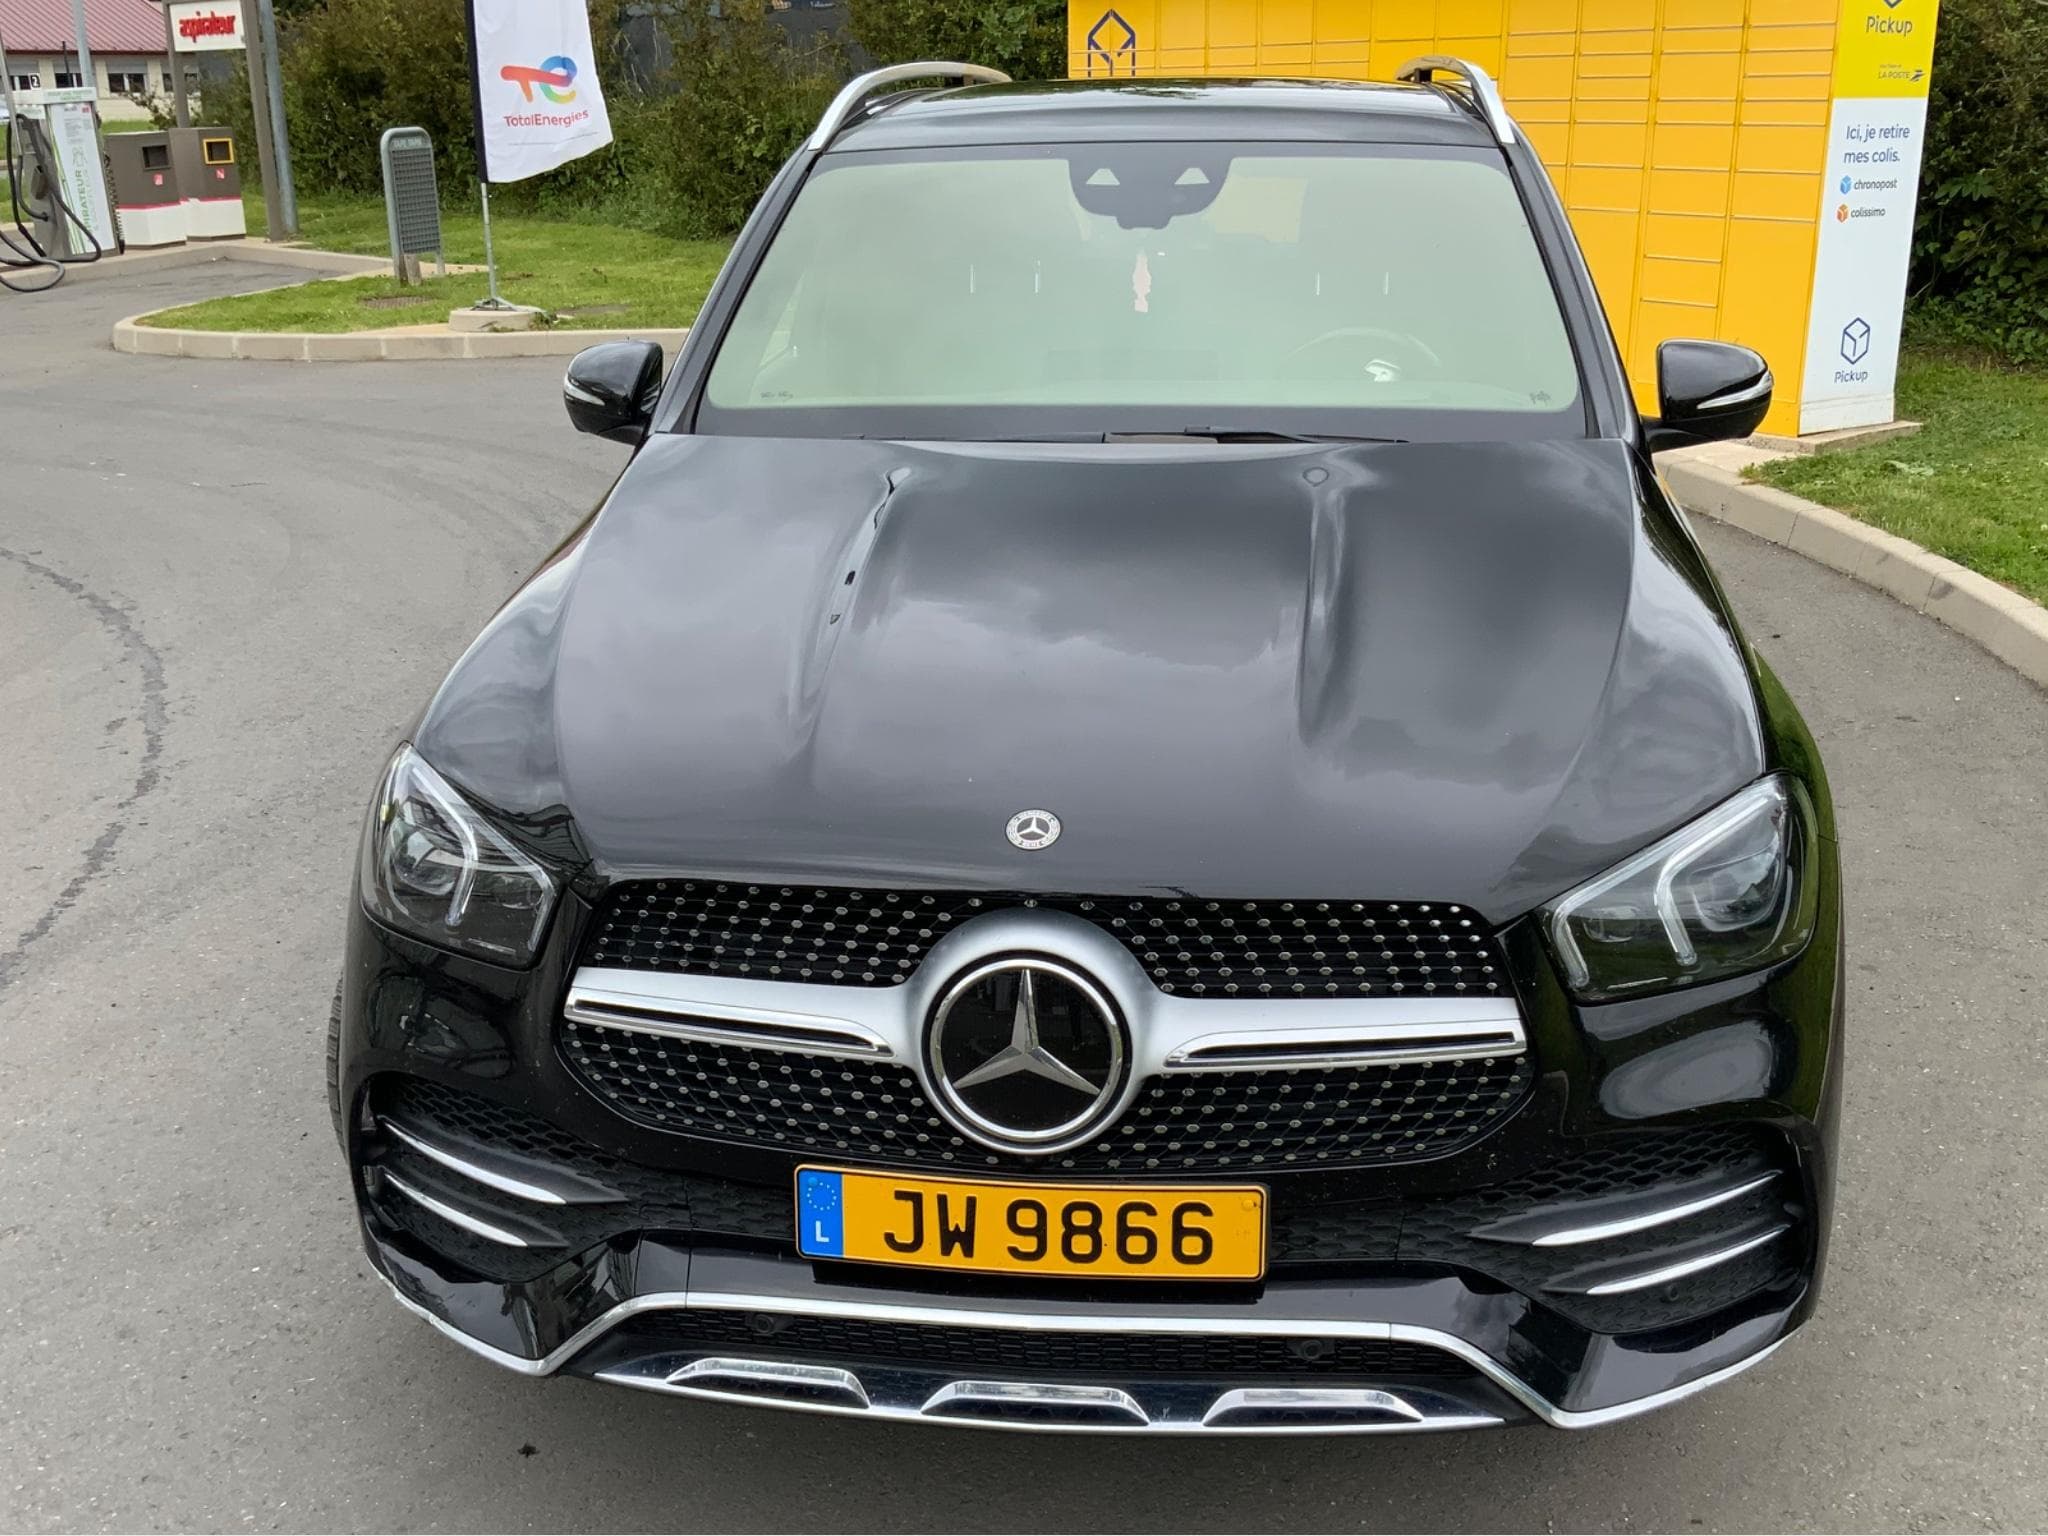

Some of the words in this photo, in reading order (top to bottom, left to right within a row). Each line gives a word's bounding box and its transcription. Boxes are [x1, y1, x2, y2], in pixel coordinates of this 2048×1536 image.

[179, 10, 236, 44] aspirateur
[1866, 14, 1913, 38] Pickup
[504, 110, 589, 128] TotalEnergies
[1846, 124, 1862, 142] Ici,
[1863, 123, 1876, 143] je
[1879, 123, 1911, 139] retire
[1843, 151, 1870, 163] mes
[1871, 147, 1901, 163] colis.
[1853, 178, 1898, 191] chronopost
[1850, 206, 1887, 218] colissimo
[1834, 370, 1869, 384] Pickup
[815, 1221, 829, 1243] L
[884, 1190, 978, 1258] JW
[1005, 1198, 1214, 1265] 9866
